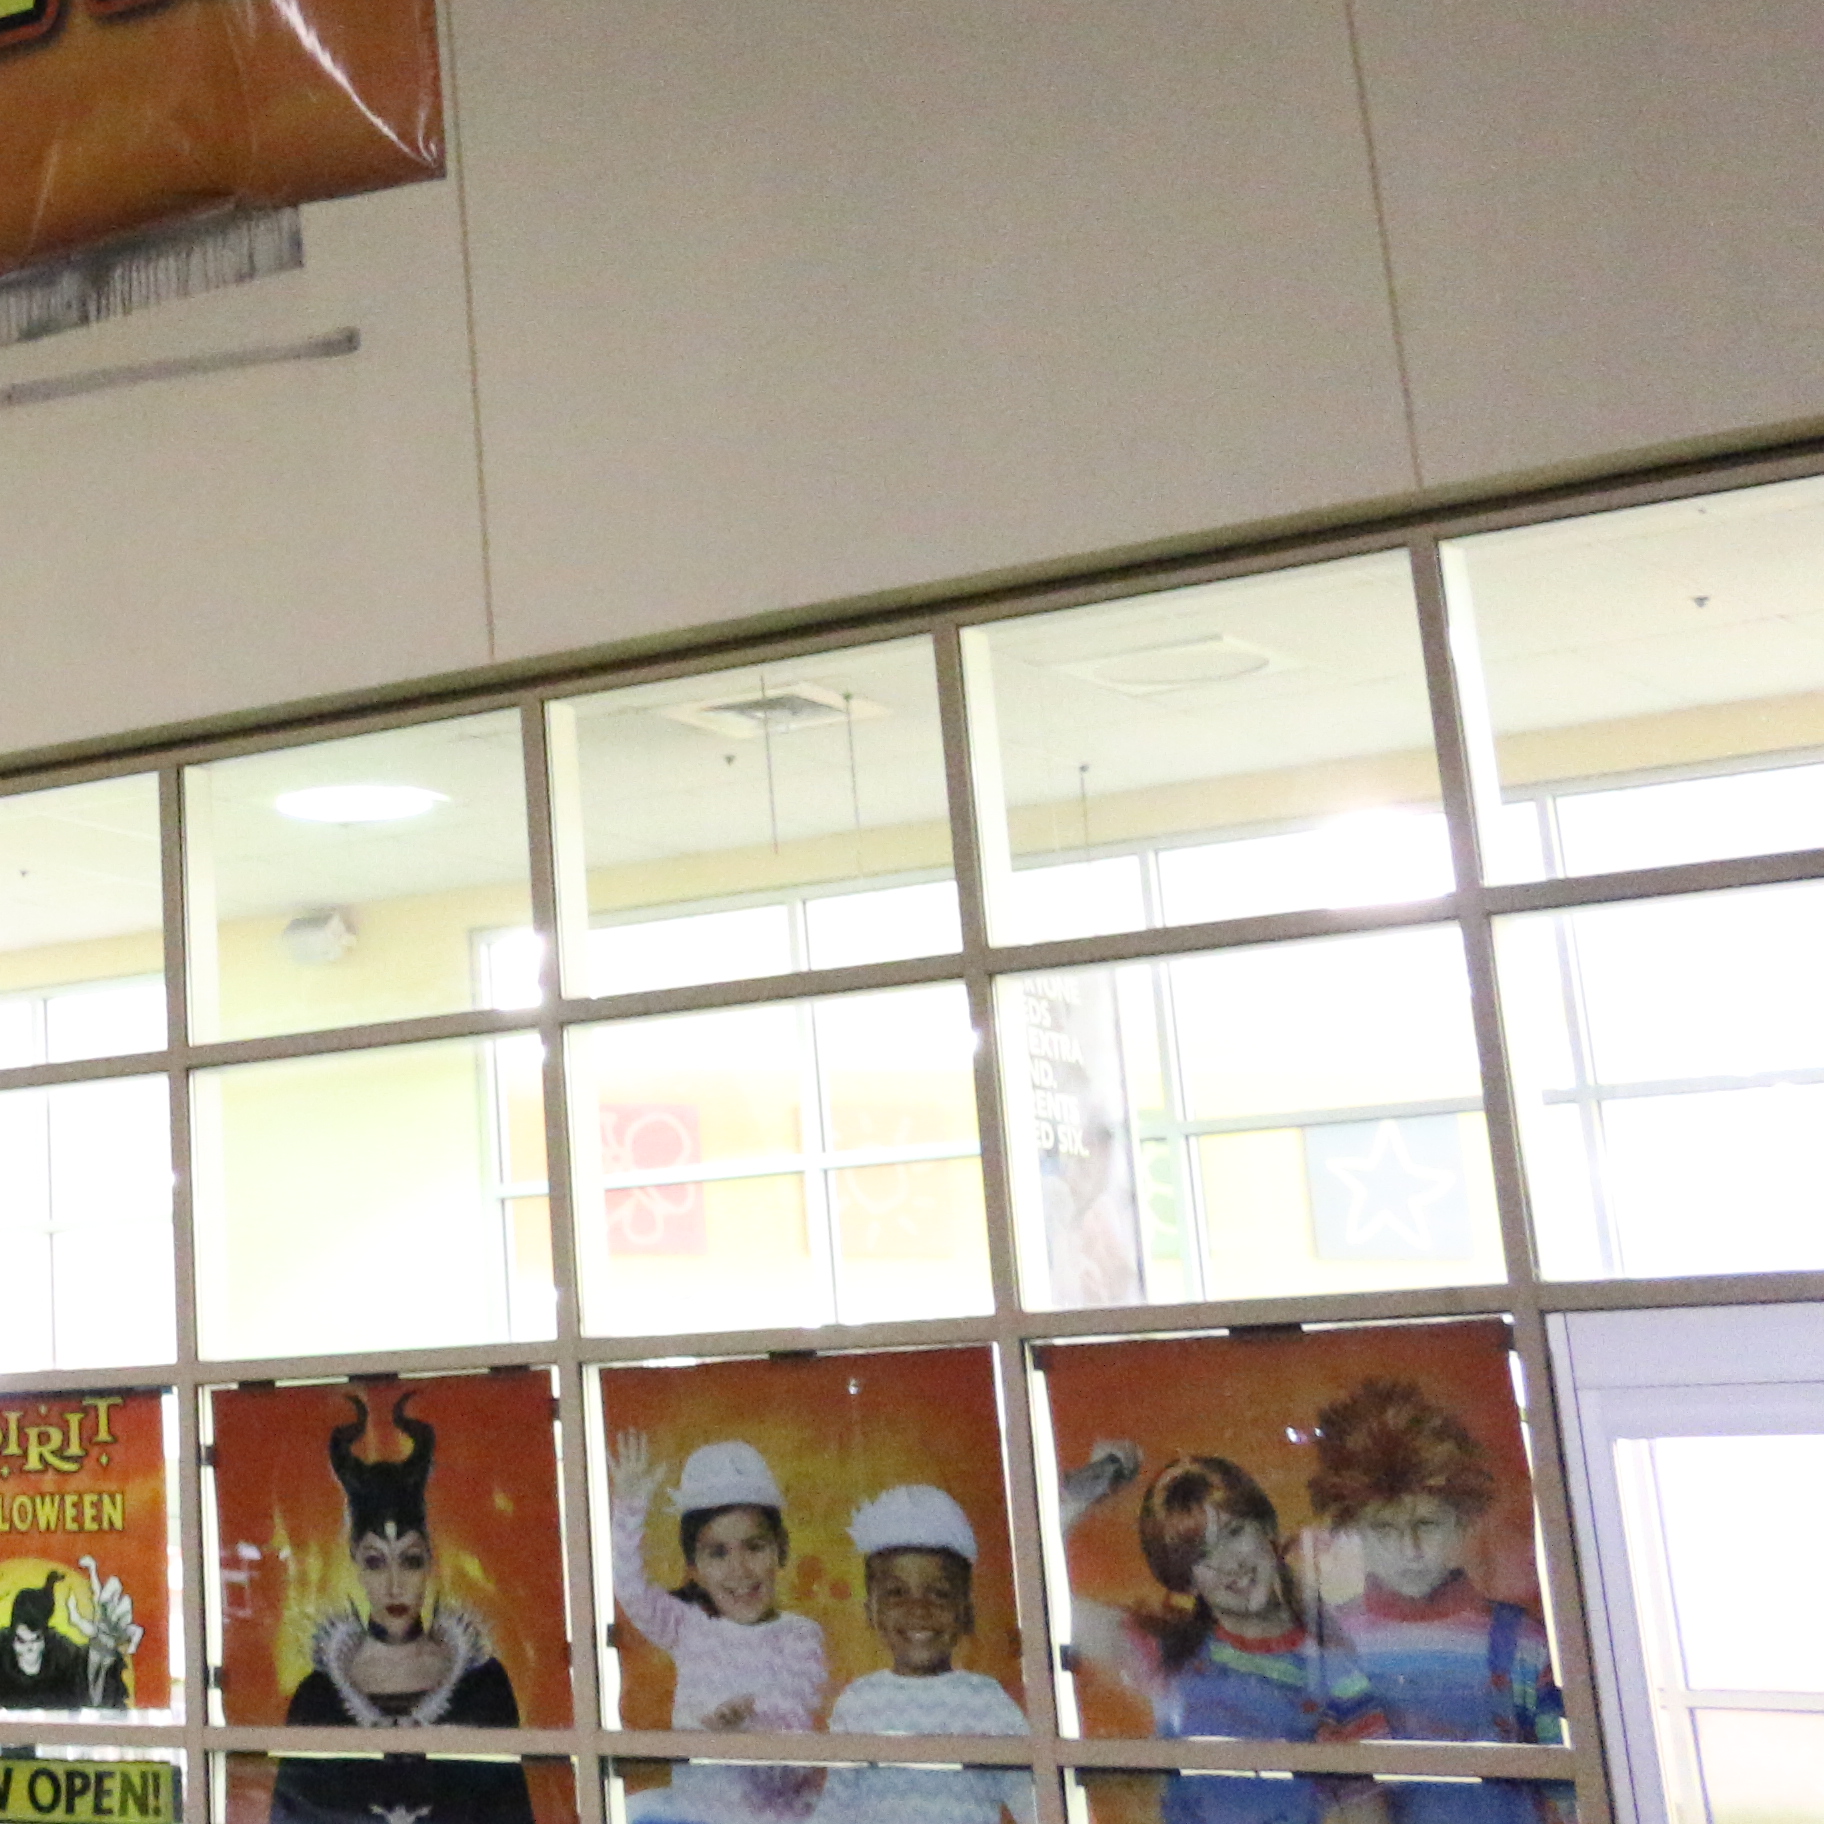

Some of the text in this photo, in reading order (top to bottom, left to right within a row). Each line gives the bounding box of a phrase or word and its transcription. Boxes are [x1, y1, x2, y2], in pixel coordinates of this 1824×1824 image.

[1027, 1027, 1084, 1065] EXTRA
[1033, 1088, 1081, 1126] ENTS
[28, 1766, 161, 1818] OPEN!
